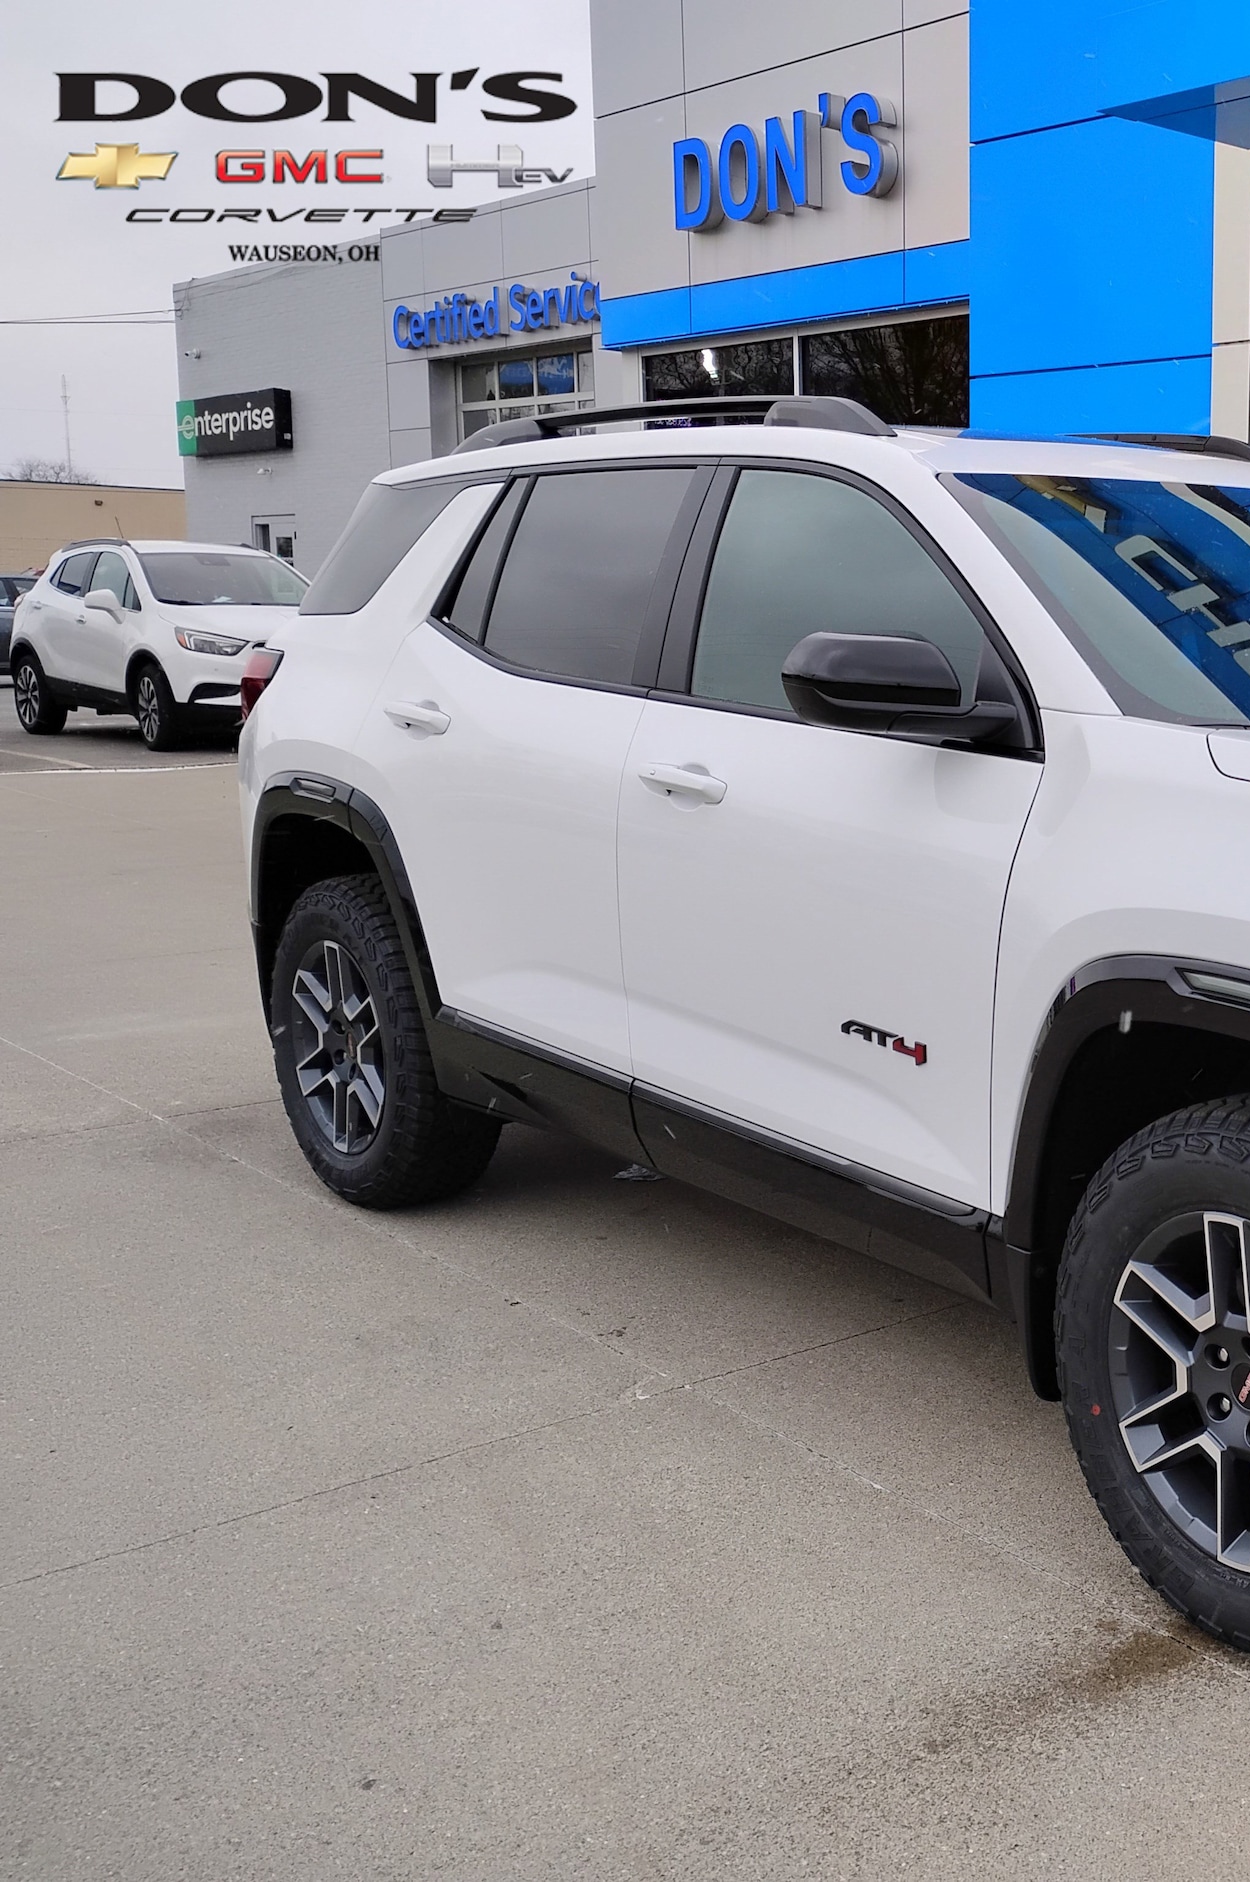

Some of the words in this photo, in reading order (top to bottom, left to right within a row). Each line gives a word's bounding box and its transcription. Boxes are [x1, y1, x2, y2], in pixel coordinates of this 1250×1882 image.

[673, 92, 897, 232] DON'S
[392, 286, 500, 349] Certified
[509, 271, 600, 331] Servic
[178, 401, 275, 441] enterprise
[841, 1019, 927, 1066] AT4
